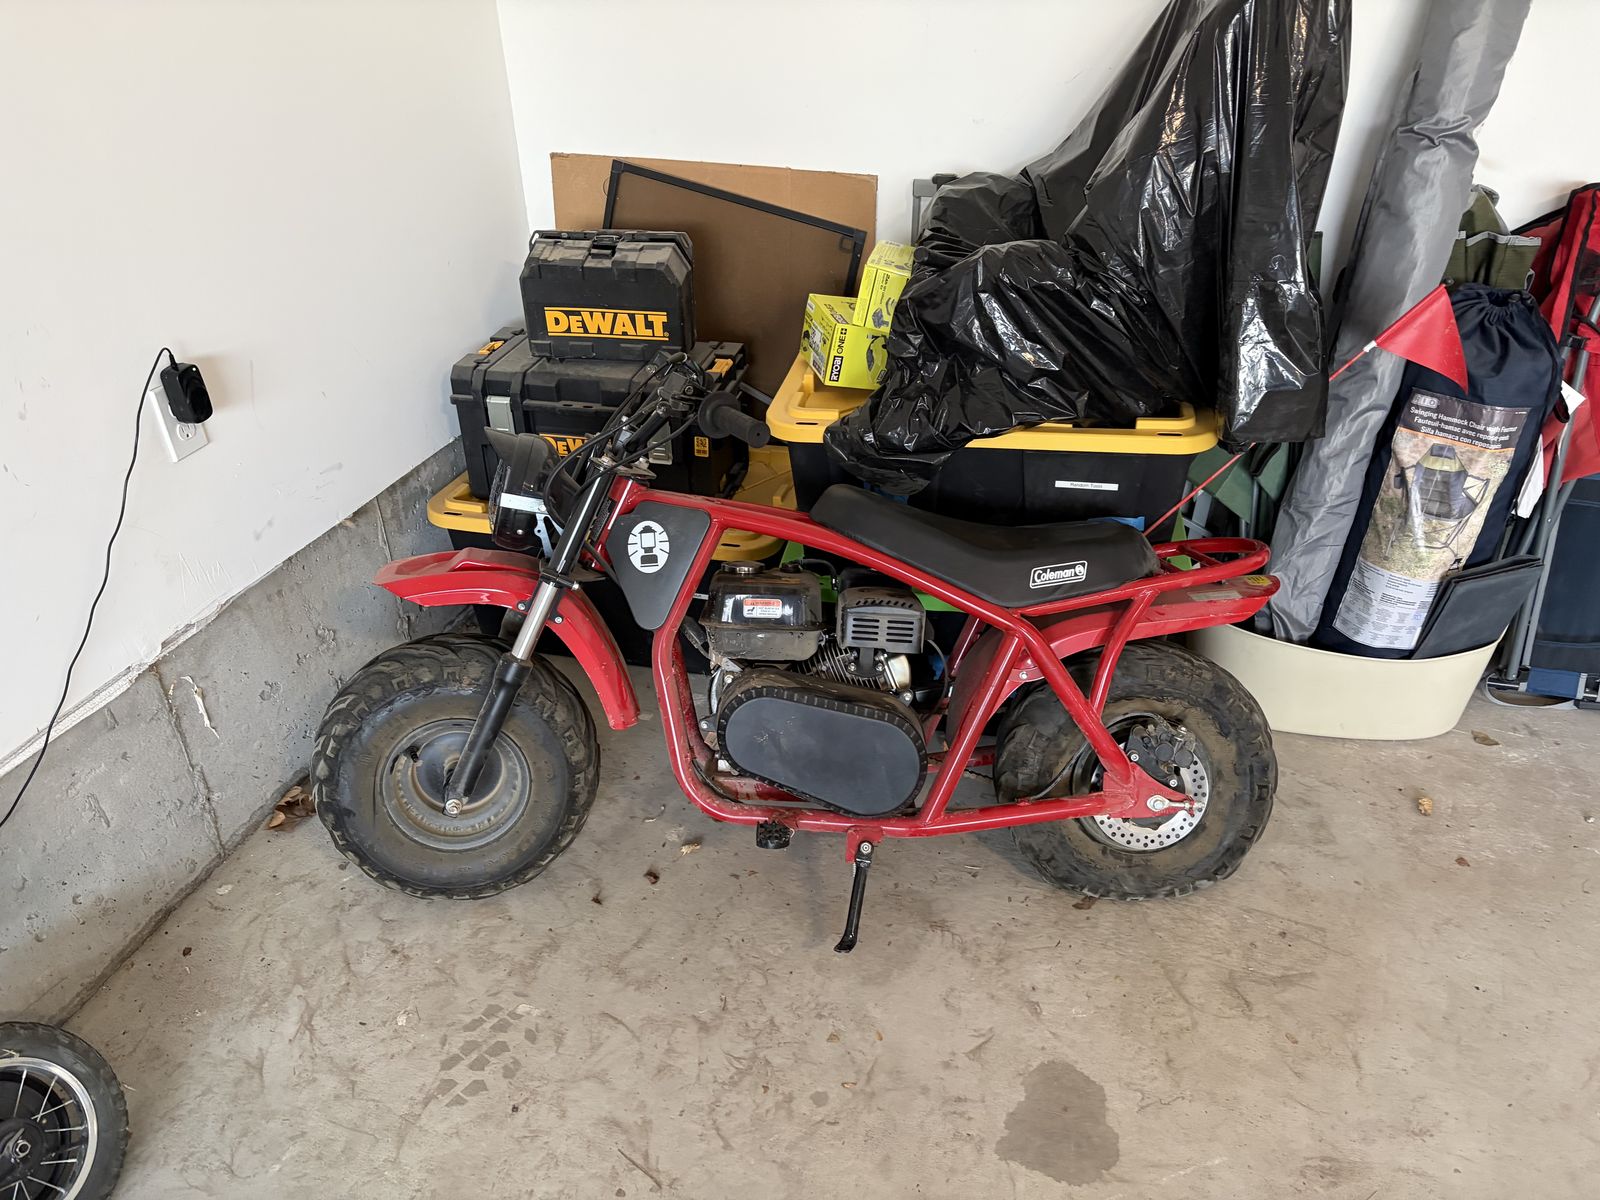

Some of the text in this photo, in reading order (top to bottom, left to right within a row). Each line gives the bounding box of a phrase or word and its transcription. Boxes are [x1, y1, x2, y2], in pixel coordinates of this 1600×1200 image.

[830, 356, 843, 381] RYOBI
[1410, 406, 1437, 419] Swinging
[1438, 413, 1468, 426] Hammock
[1469, 420, 1486, 431] Chair
[1420, 426, 1435, 435] Silla
[1435, 430, 1459, 441] hamaca
[1460, 436, 1472, 444] con
[1462, 428, 1476, 437] avec
[1034, 568, 1075, 583] Coleman
